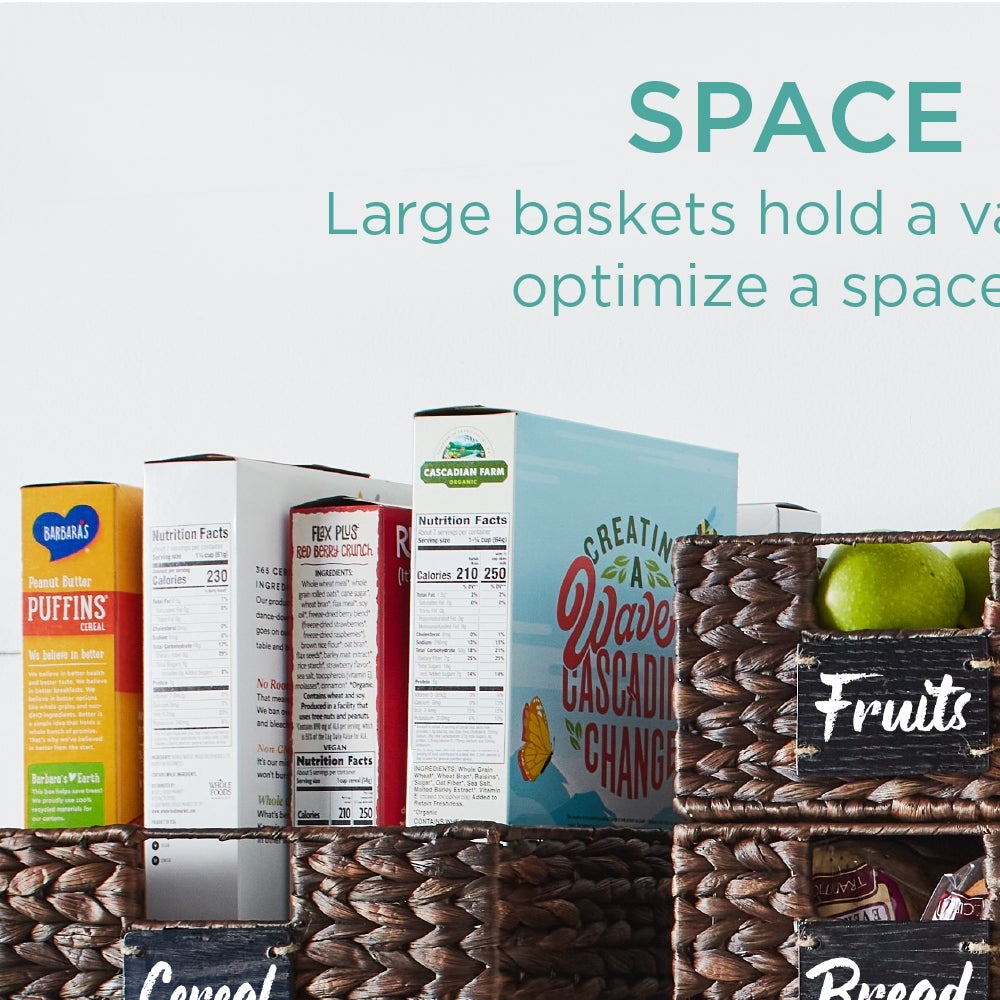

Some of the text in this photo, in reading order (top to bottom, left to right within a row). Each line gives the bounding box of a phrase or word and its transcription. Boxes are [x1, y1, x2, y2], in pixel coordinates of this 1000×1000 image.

[423, 467, 505, 477] CASCADIAN FARM
[418, 515, 508, 526] Nutrition Facts
[152, 527, 229, 541] Nutrition Facts
[255, 566, 270, 575] 365
[417, 567, 506, 580] Calories 210 250
[630, 556, 643, 589] A
[28, 576, 92, 588] Peanut Butter
[152, 569, 228, 586] Calories 230
[27, 594, 106, 622] PUFFINS
[556, 556, 675, 670] Wave
[80, 622, 106, 631] CEREAL
[28, 649, 104, 660] We believe in better
[257, 678, 269, 689] No
[814, 672, 972, 743] Fruits
[296, 755, 373, 767] Nutrition Facts
[77, 772, 100, 784] Earth
[297, 807, 373, 820] Calories 210 250
